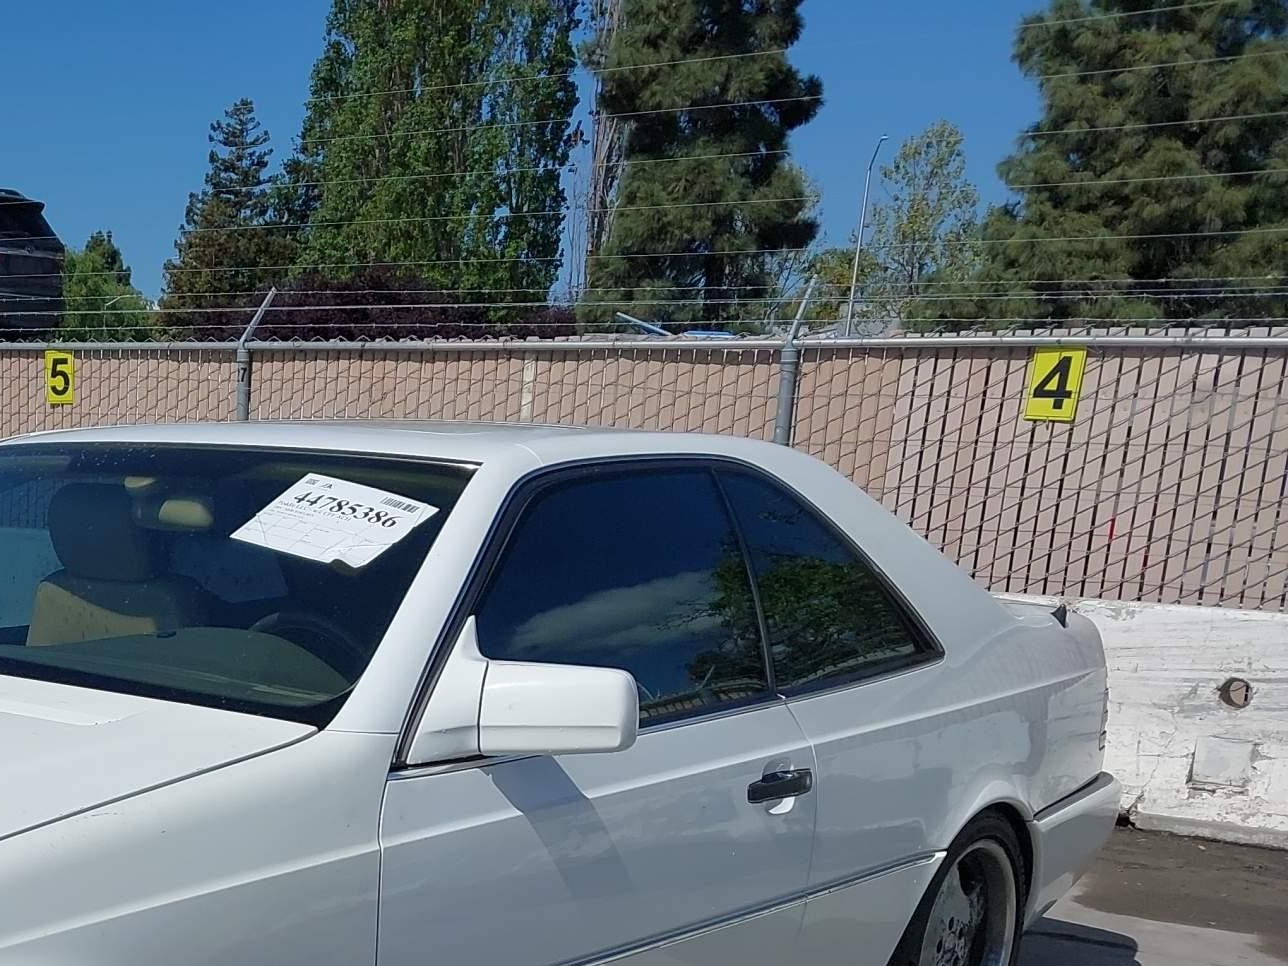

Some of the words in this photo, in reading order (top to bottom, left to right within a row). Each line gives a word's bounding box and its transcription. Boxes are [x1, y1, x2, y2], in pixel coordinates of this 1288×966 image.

[50, 357, 70, 396] 5
[1032, 355, 1073, 410] 4
[293, 491, 400, 529] 44785386
